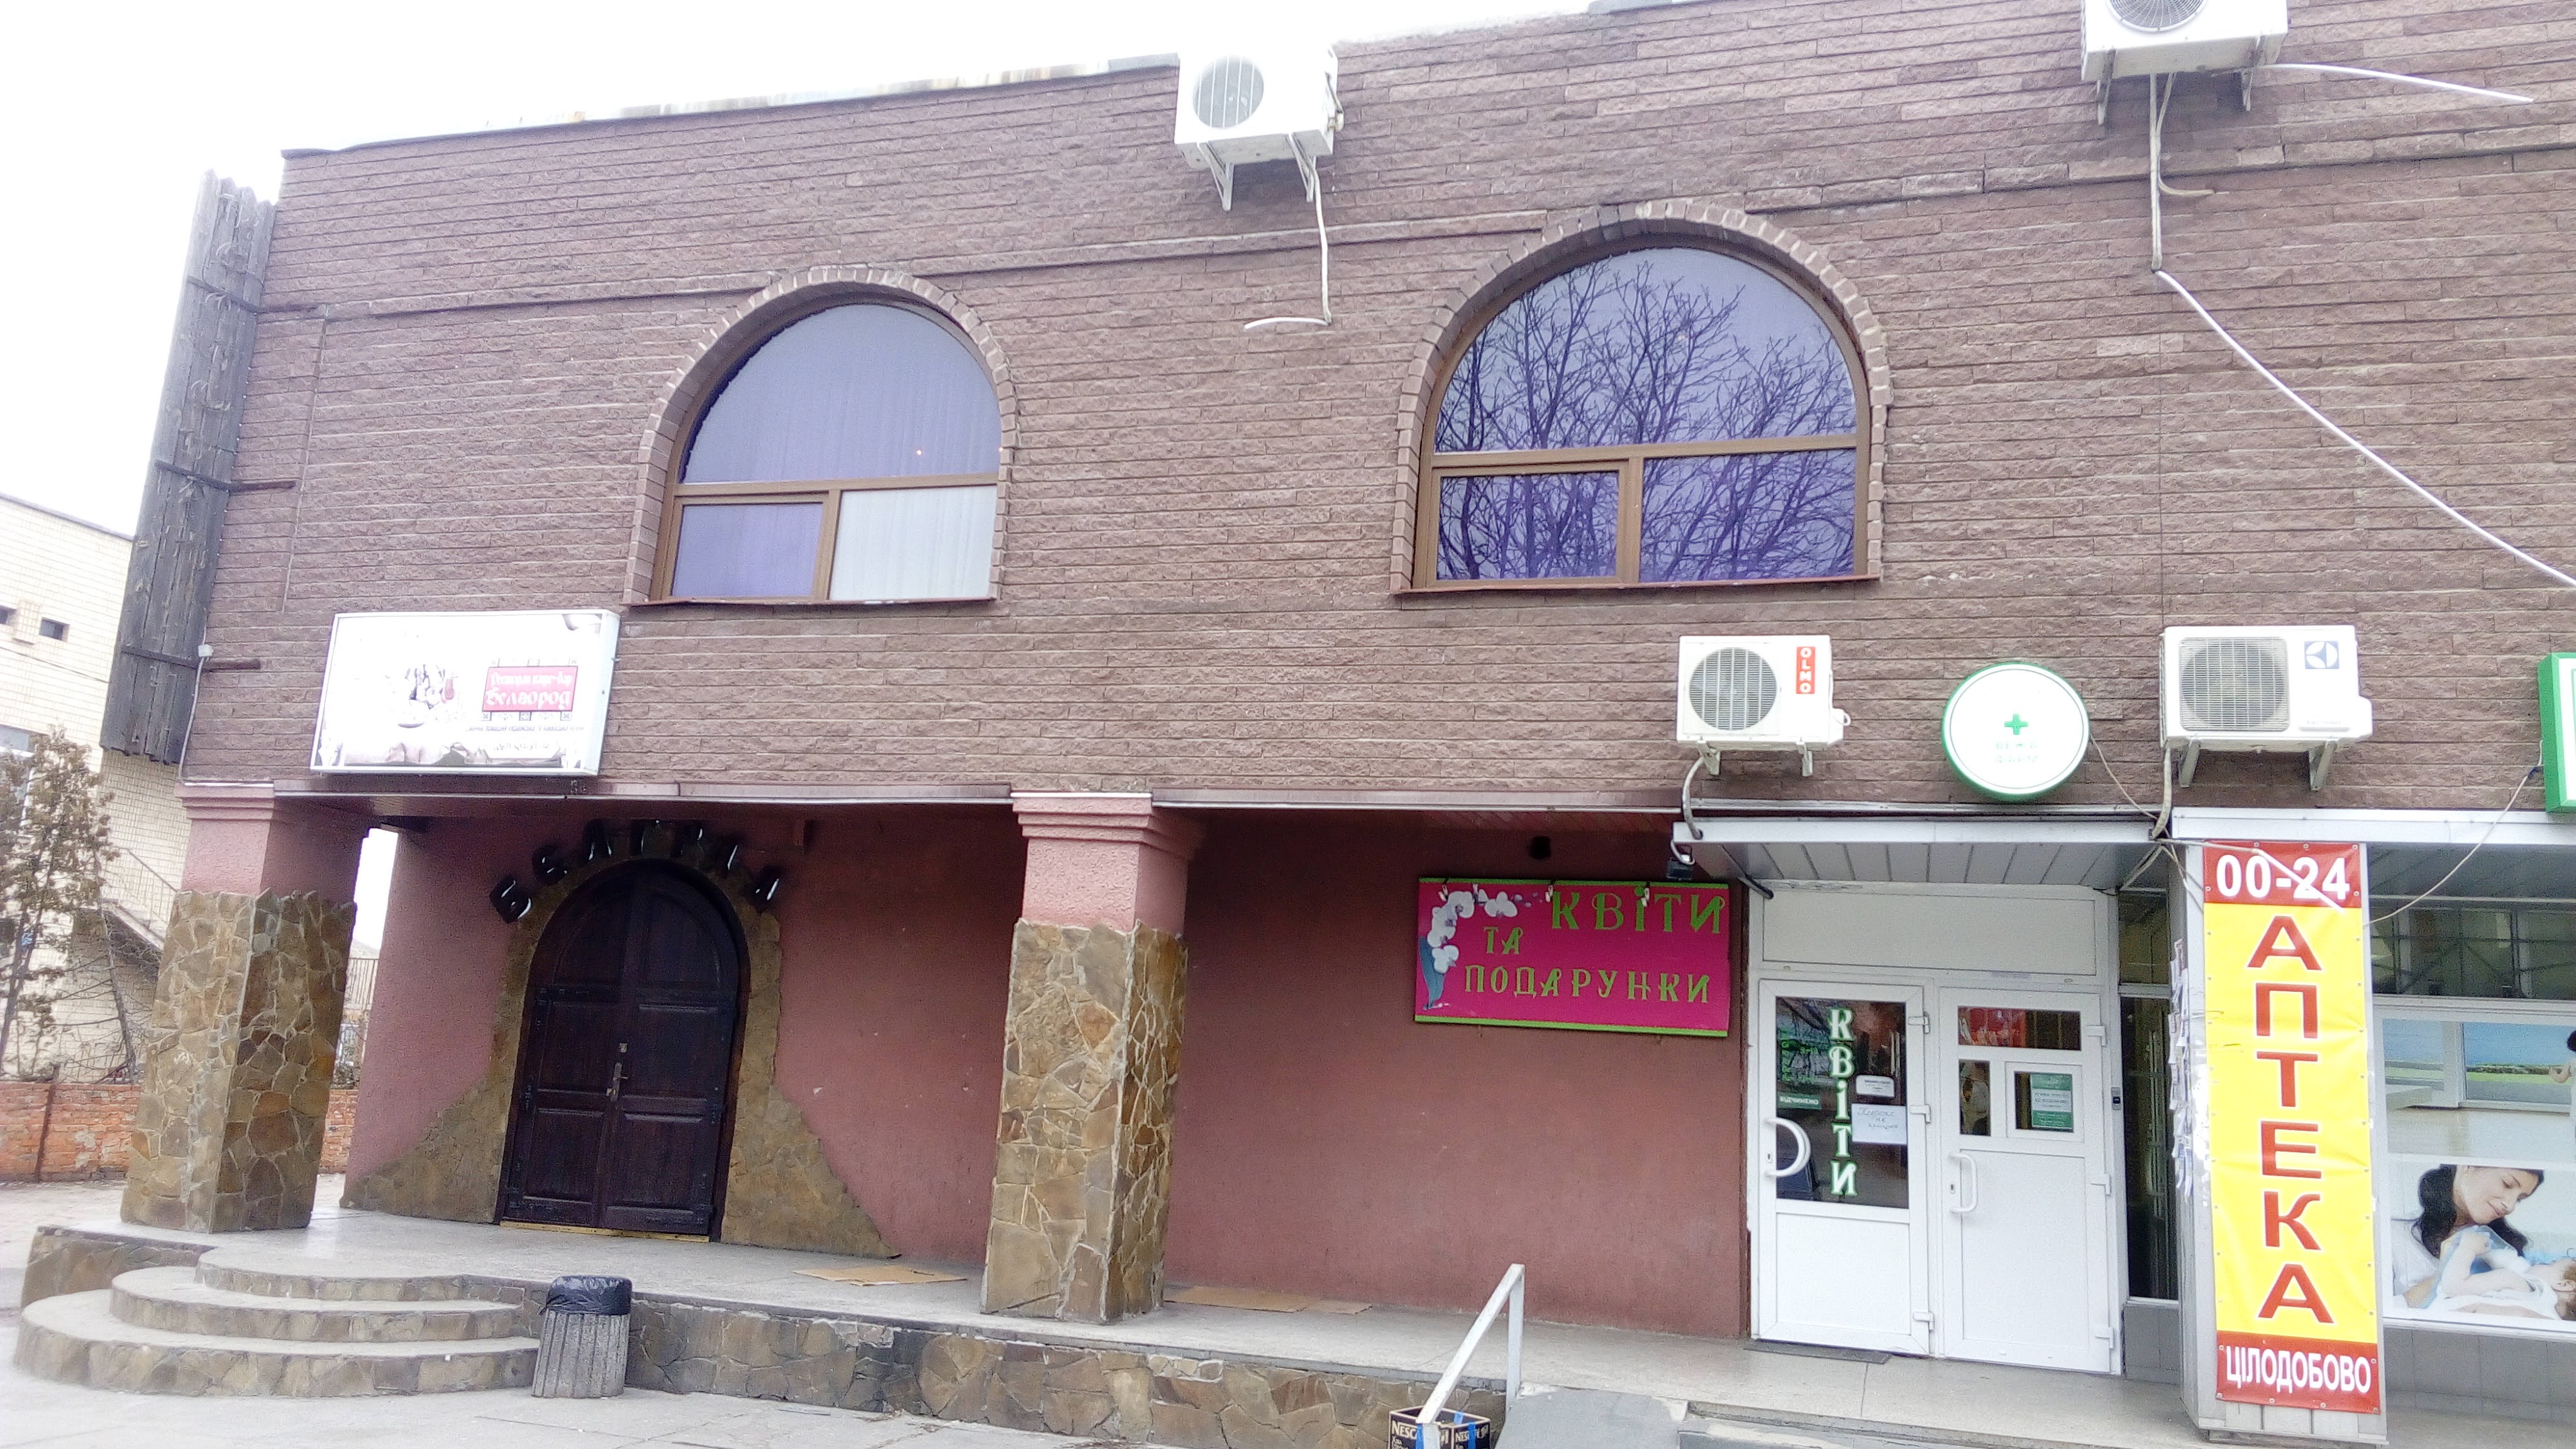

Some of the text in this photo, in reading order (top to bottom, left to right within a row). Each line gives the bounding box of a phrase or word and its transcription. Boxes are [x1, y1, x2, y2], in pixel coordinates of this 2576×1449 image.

[1799, 647, 1812, 693] OLMO
[2216, 853, 2351, 901] 00-24
[1484, 926, 1524, 955] ТА
[1465, 965, 1710, 1003] ПОДАРУНКИ
[2245, 914, 2336, 1324] АПТЕКА
[2226, 1345, 2372, 1394] ЦІЛОДОБОВО
